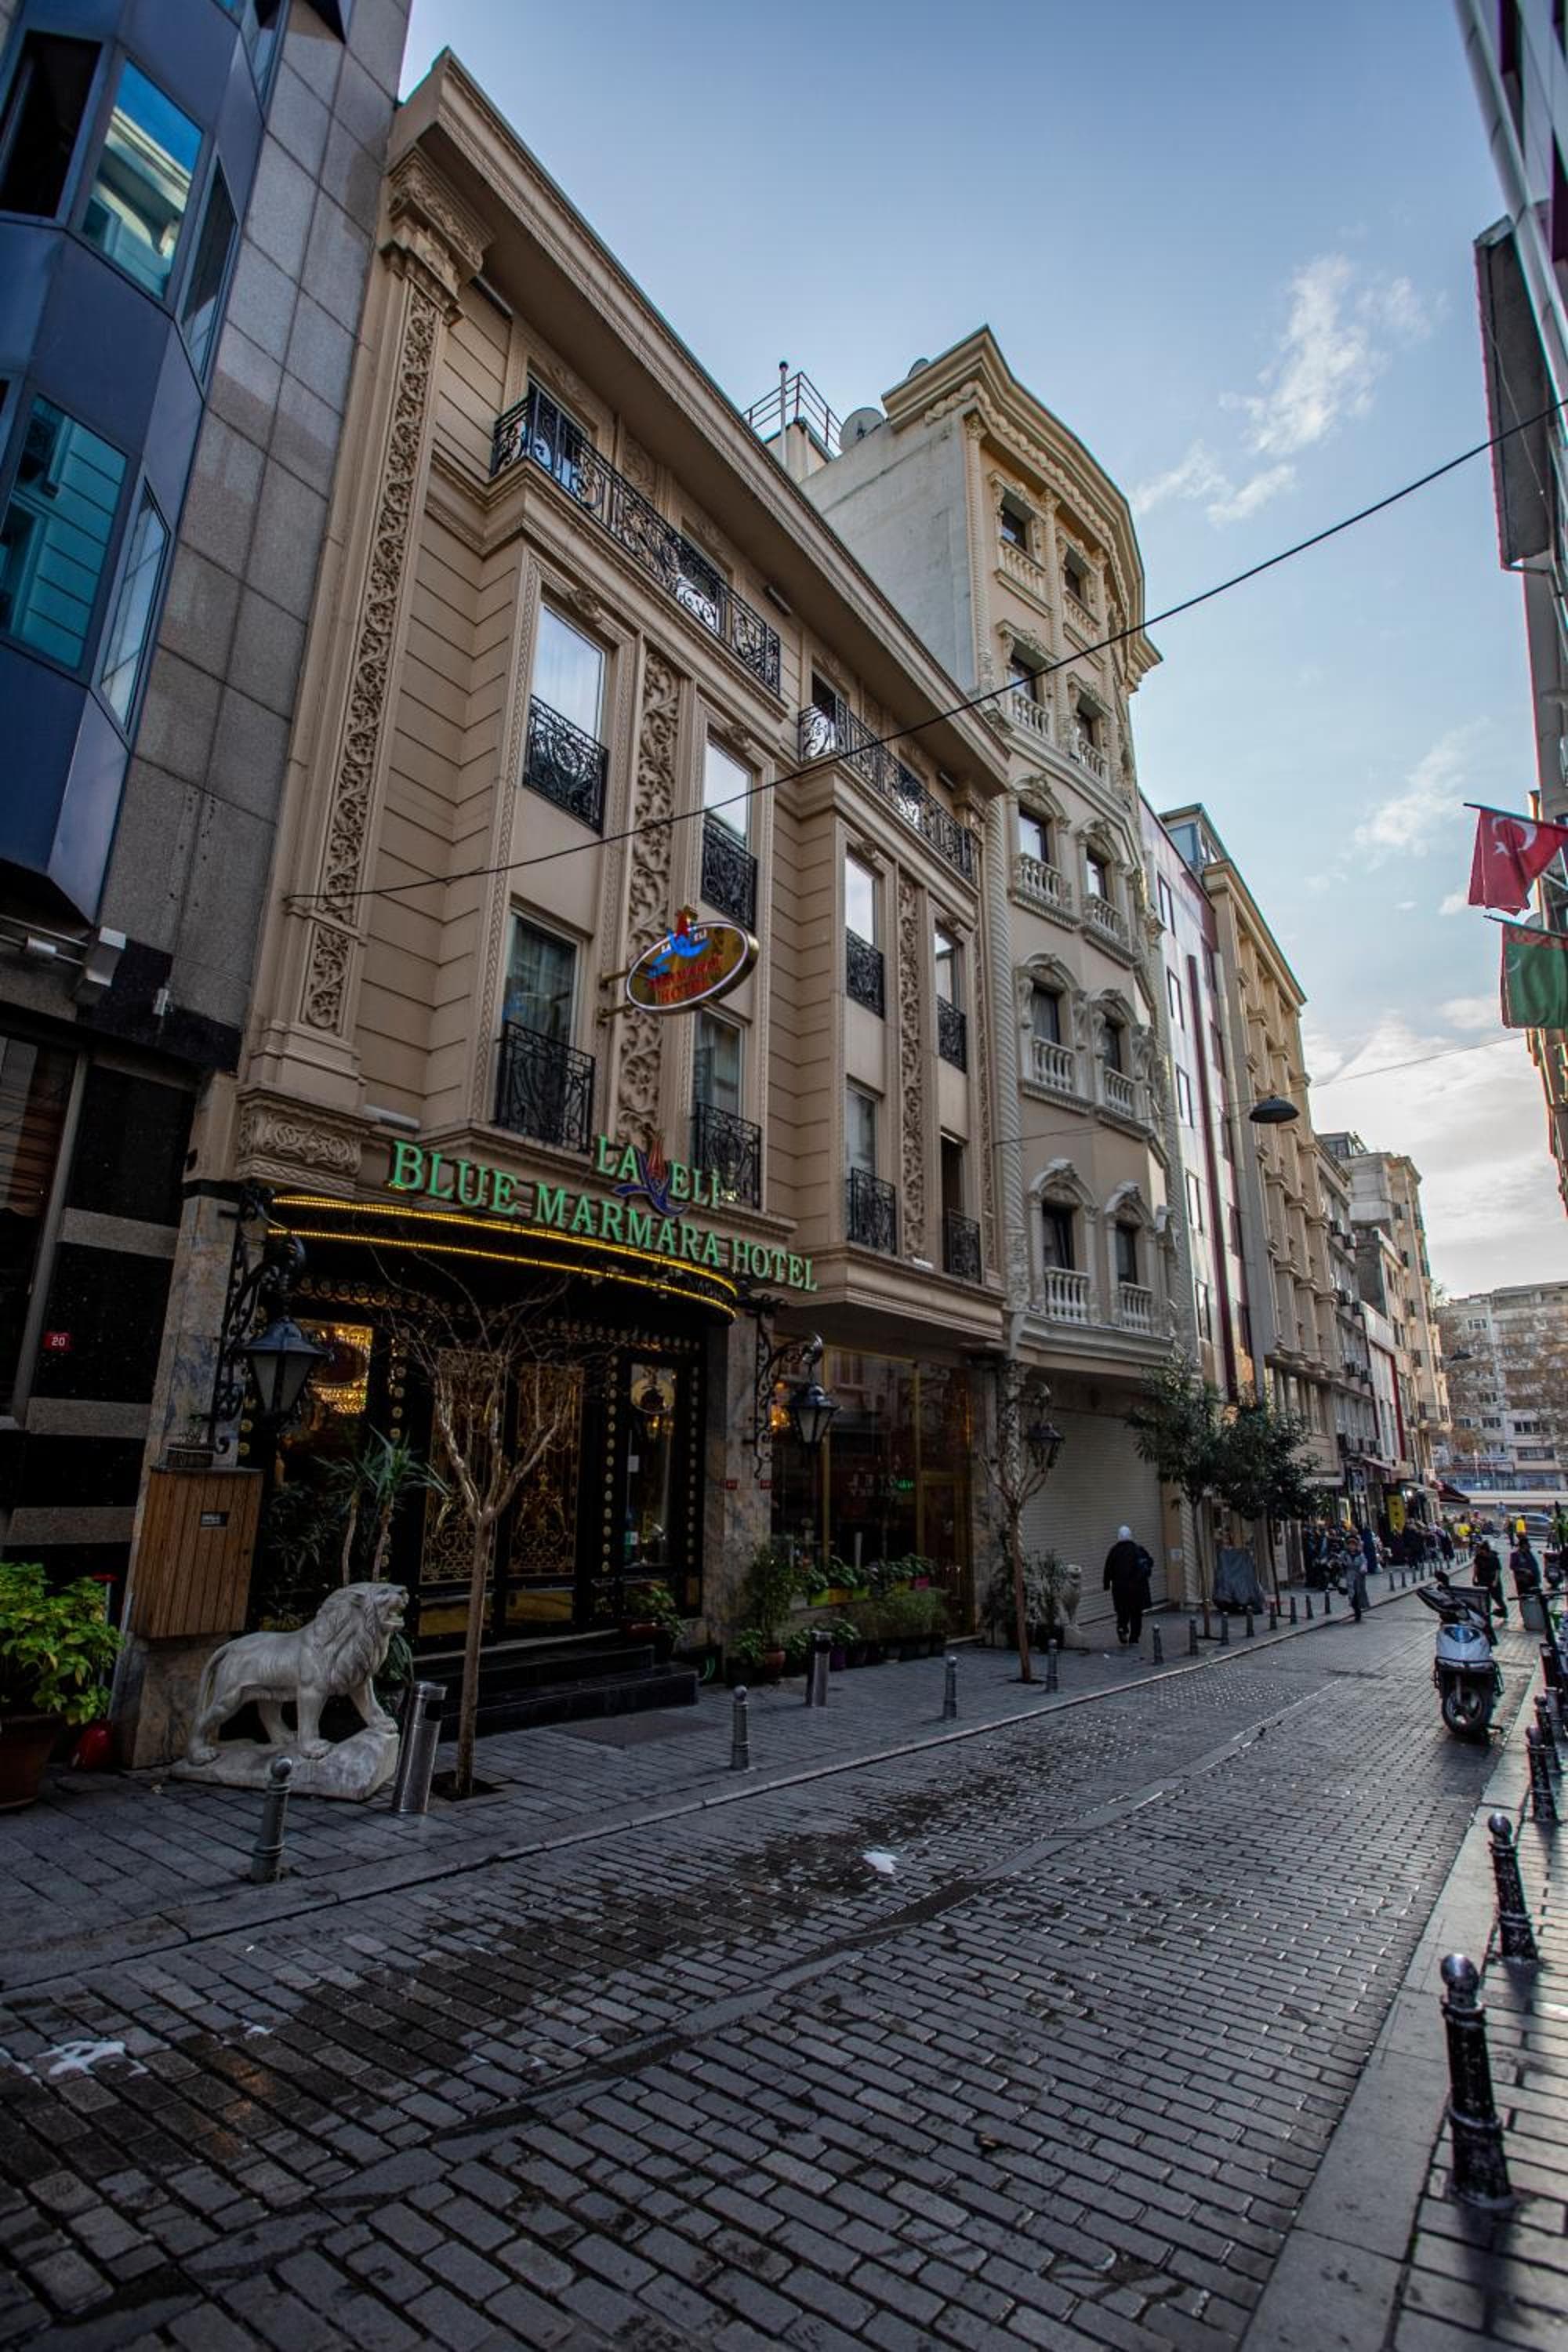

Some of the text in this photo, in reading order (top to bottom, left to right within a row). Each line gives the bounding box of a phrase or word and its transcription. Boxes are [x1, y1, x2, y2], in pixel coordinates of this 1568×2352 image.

[392, 1141, 817, 1291] BLUE MARMARA HOTEL
[52, 1337, 66, 1347] 20
